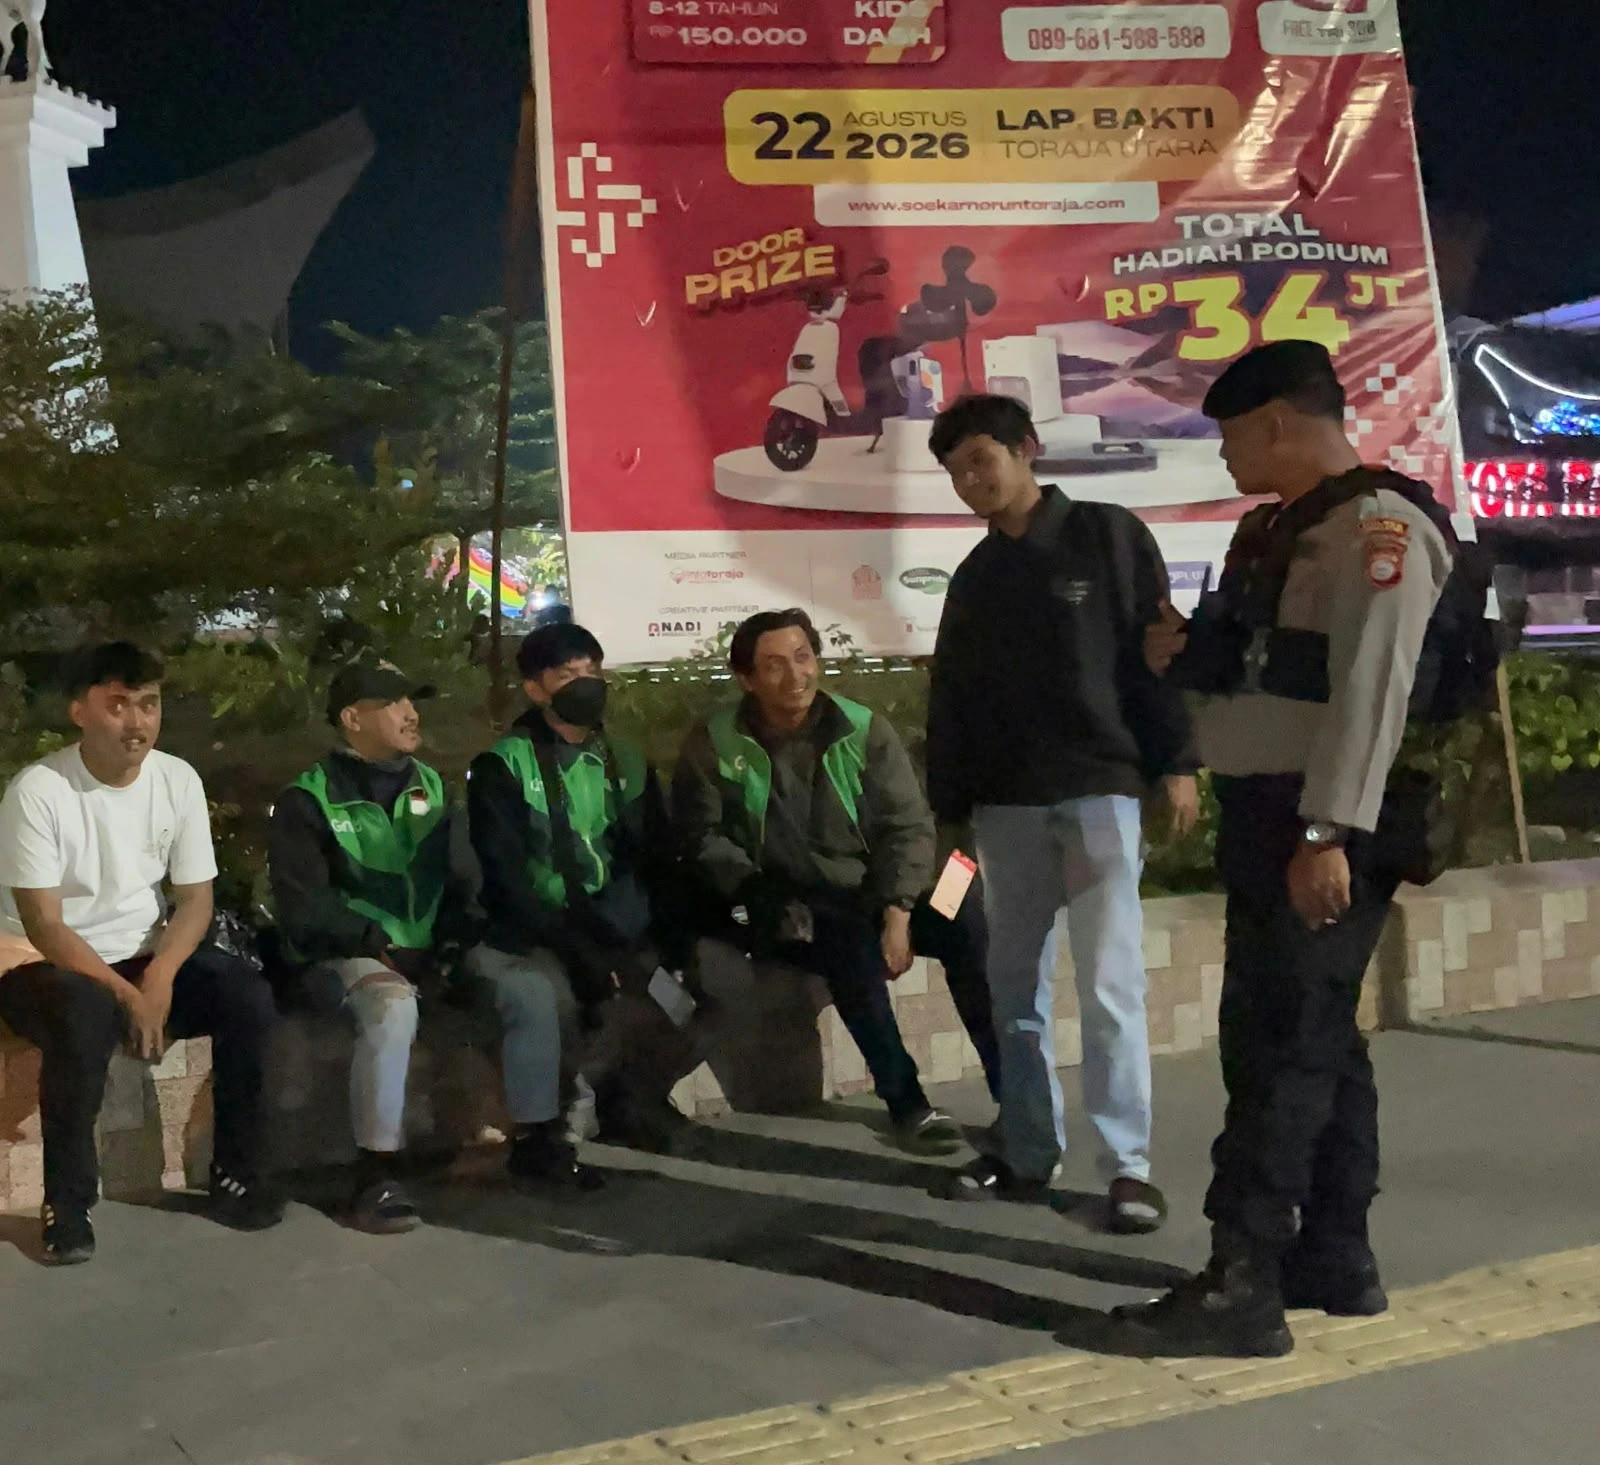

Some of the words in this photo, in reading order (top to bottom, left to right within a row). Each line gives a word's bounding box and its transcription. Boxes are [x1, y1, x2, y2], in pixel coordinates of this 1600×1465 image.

[705, 2, 778, 15] TAHUN
[855, 0, 929, 18] KID
[678, 26, 808, 45] 150.000
[843, 111, 967, 127] AGUSTUS
[1093, 107, 1214, 129] BAKTI
[750, 111, 834, 160] 22
[846, 132, 970, 159] 2026
[998, 140, 1113, 158] TORAJA
[1118, 138, 1219, 158] UTARA
[847, 198, 1126, 213] www.soekarnoruntoraja.com
[1175, 212, 1320, 239] TOTAL
[713, 228, 805, 267] DOOR
[1113, 243, 1243, 275] HADIAH
[1252, 242, 1388, 265] PODIUM
[685, 245, 836, 304] PRIZE
[1104, 283, 1167, 319] RP
[1173, 273, 1350, 361] 34
[1350, 275, 1405, 306] JT
[659, 606, 708, 614] CREATIVE
[711, 604, 760, 613] PARTNER
